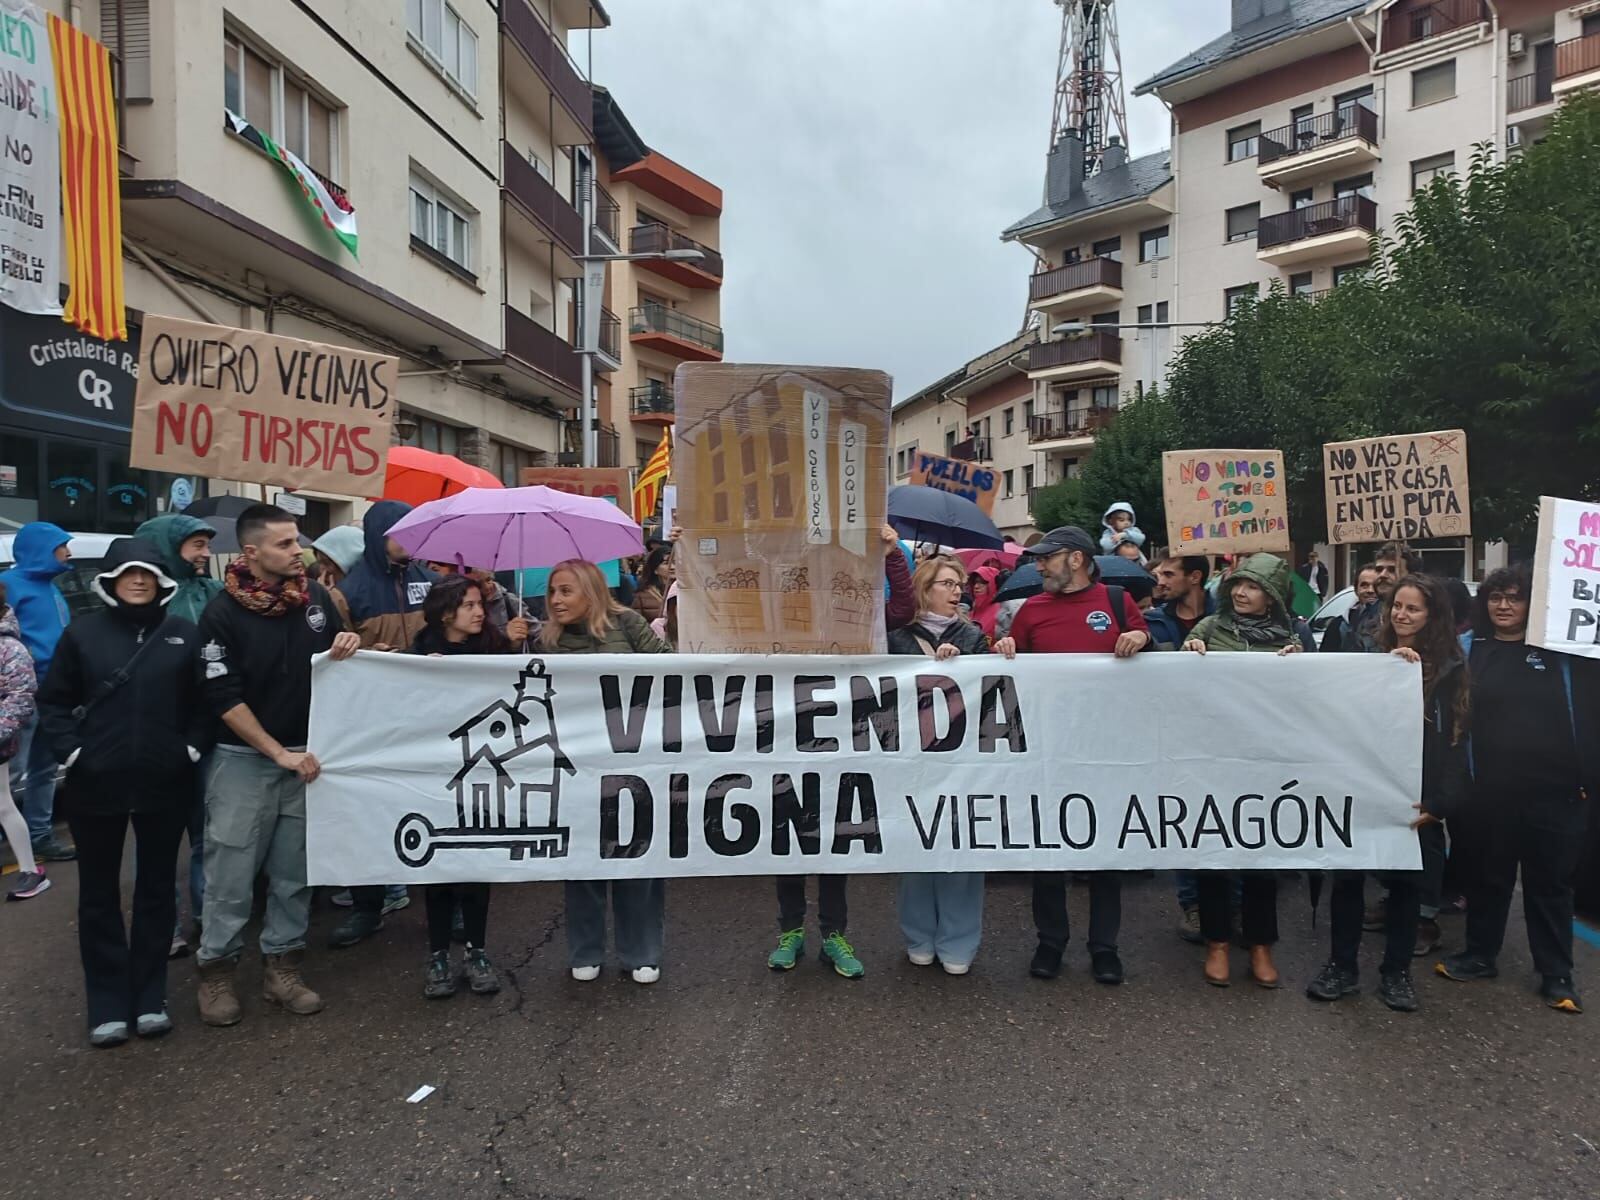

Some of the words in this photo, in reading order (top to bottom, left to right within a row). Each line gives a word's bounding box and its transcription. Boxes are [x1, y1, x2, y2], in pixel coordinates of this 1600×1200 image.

[4, 134, 33, 165] NO
[1, 258, 42, 283] PUEBLO
[31, 256, 45, 269] EL
[29, 337, 117, 366] Cristalería
[150, 333, 259, 395] QUIERO
[78, 369, 114, 410] CR
[810, 398, 821, 440] VPO
[155, 400, 213, 458] NO
[238, 410, 379, 476] TURISTAS
[1180, 459, 1210, 484] NO
[1215, 460, 1275, 478] VAMOS
[1330, 448, 1357, 471] NO
[1361, 443, 1402, 468] VAS
[1405, 441, 1420, 465] A
[844, 430, 856, 523] BLOQUE
[1329, 469, 1398, 496] TENER
[1402, 465, 1452, 490] CASA
[1196, 486, 1210, 501] A
[1336, 499, 1364, 523] EN
[1366, 495, 1395, 520] TU
[1403, 490, 1462, 517] PUTA
[1181, 523, 1204, 541] EN
[1209, 521, 1228, 538] LA
[600, 674, 1027, 754] VIVIENDA
[600, 772, 881, 861] DIGNA
[905, 793, 1098, 850] VIELLO
[1117, 780, 1353, 850] ARAGÓN
